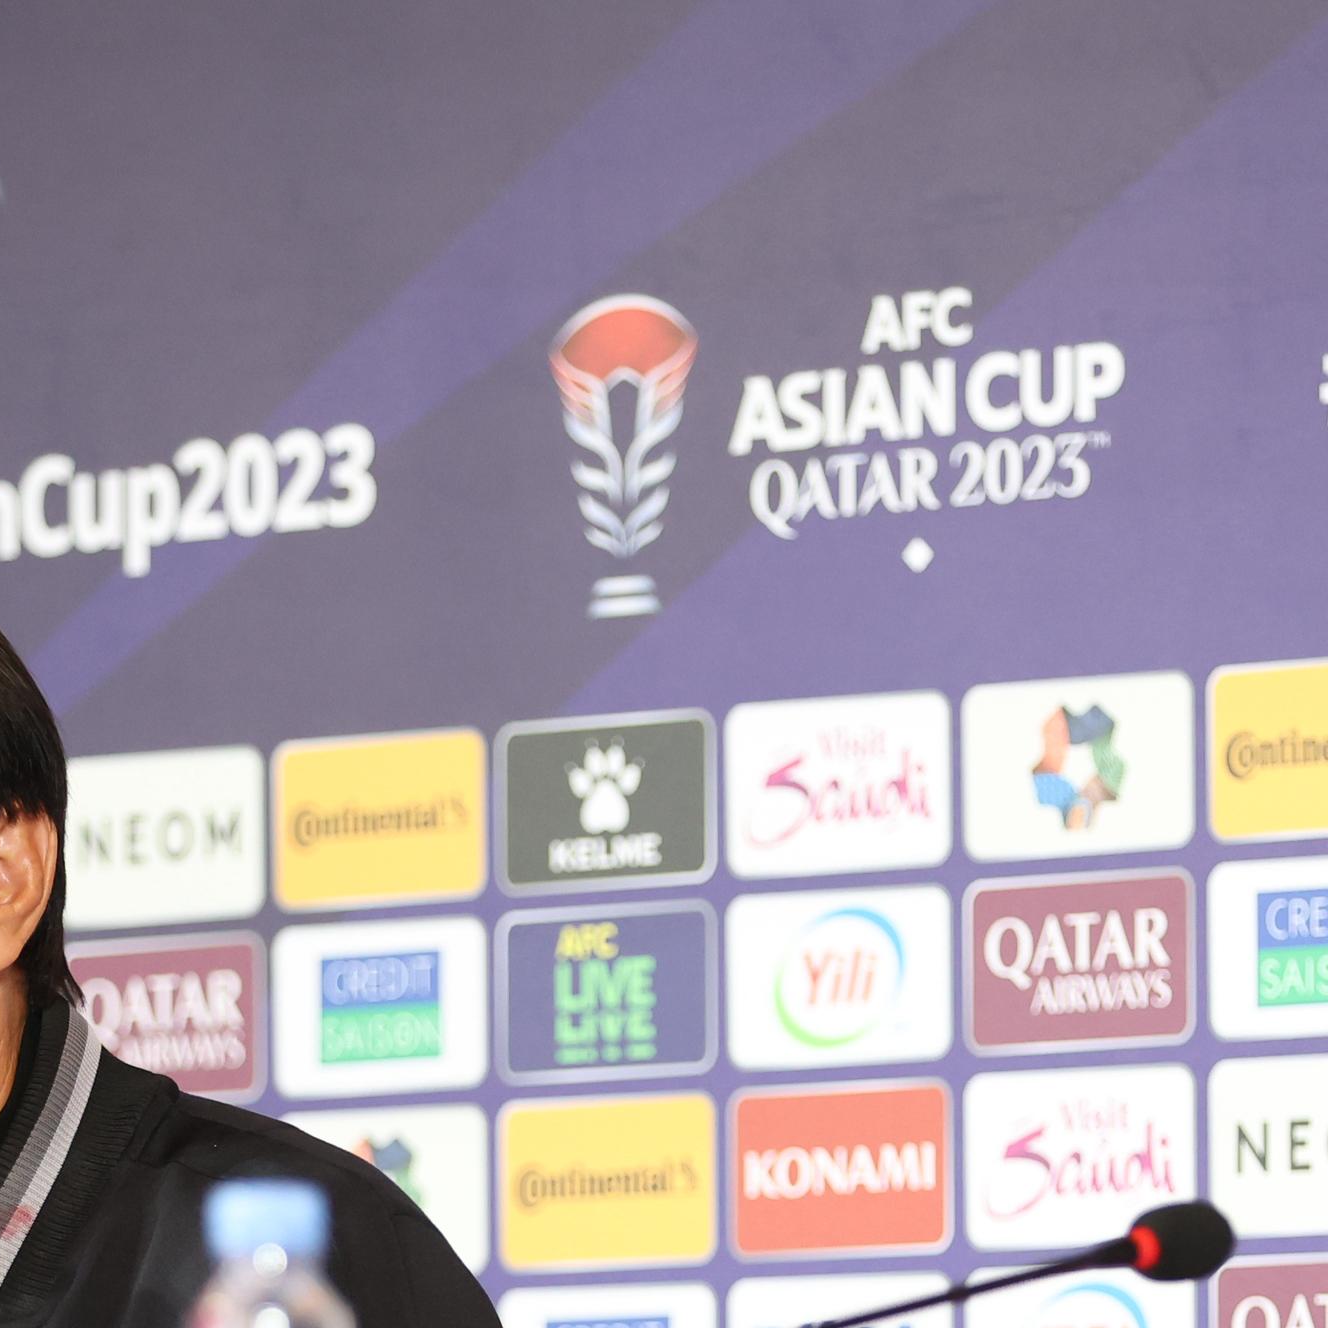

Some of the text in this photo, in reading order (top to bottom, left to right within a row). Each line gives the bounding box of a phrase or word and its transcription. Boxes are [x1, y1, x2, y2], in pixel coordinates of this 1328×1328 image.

[862, 287, 973, 354] AFC
[728, 342, 1126, 456] ASIAN CUP
[750, 446, 942, 540] QATAR
[293, 800, 439, 848] Continental
[745, 751, 931, 849] Saudi
[79, 809, 243, 866] NEOM
[549, 833, 663, 874] KELME
[555, 922, 620, 960] AFC
[984, 907, 1171, 990] QATAR
[324, 955, 433, 1004] CREDIT
[553, 955, 657, 1010] LIVE
[804, 946, 877, 1006] Yili
[1030, 969, 1173, 1016] AIRWAYS
[77, 969, 245, 1053] QATAR
[518, 1159, 673, 1206] Continental
[743, 1141, 937, 1200] KONAMI
[985, 1122, 1176, 1221] Saudi
